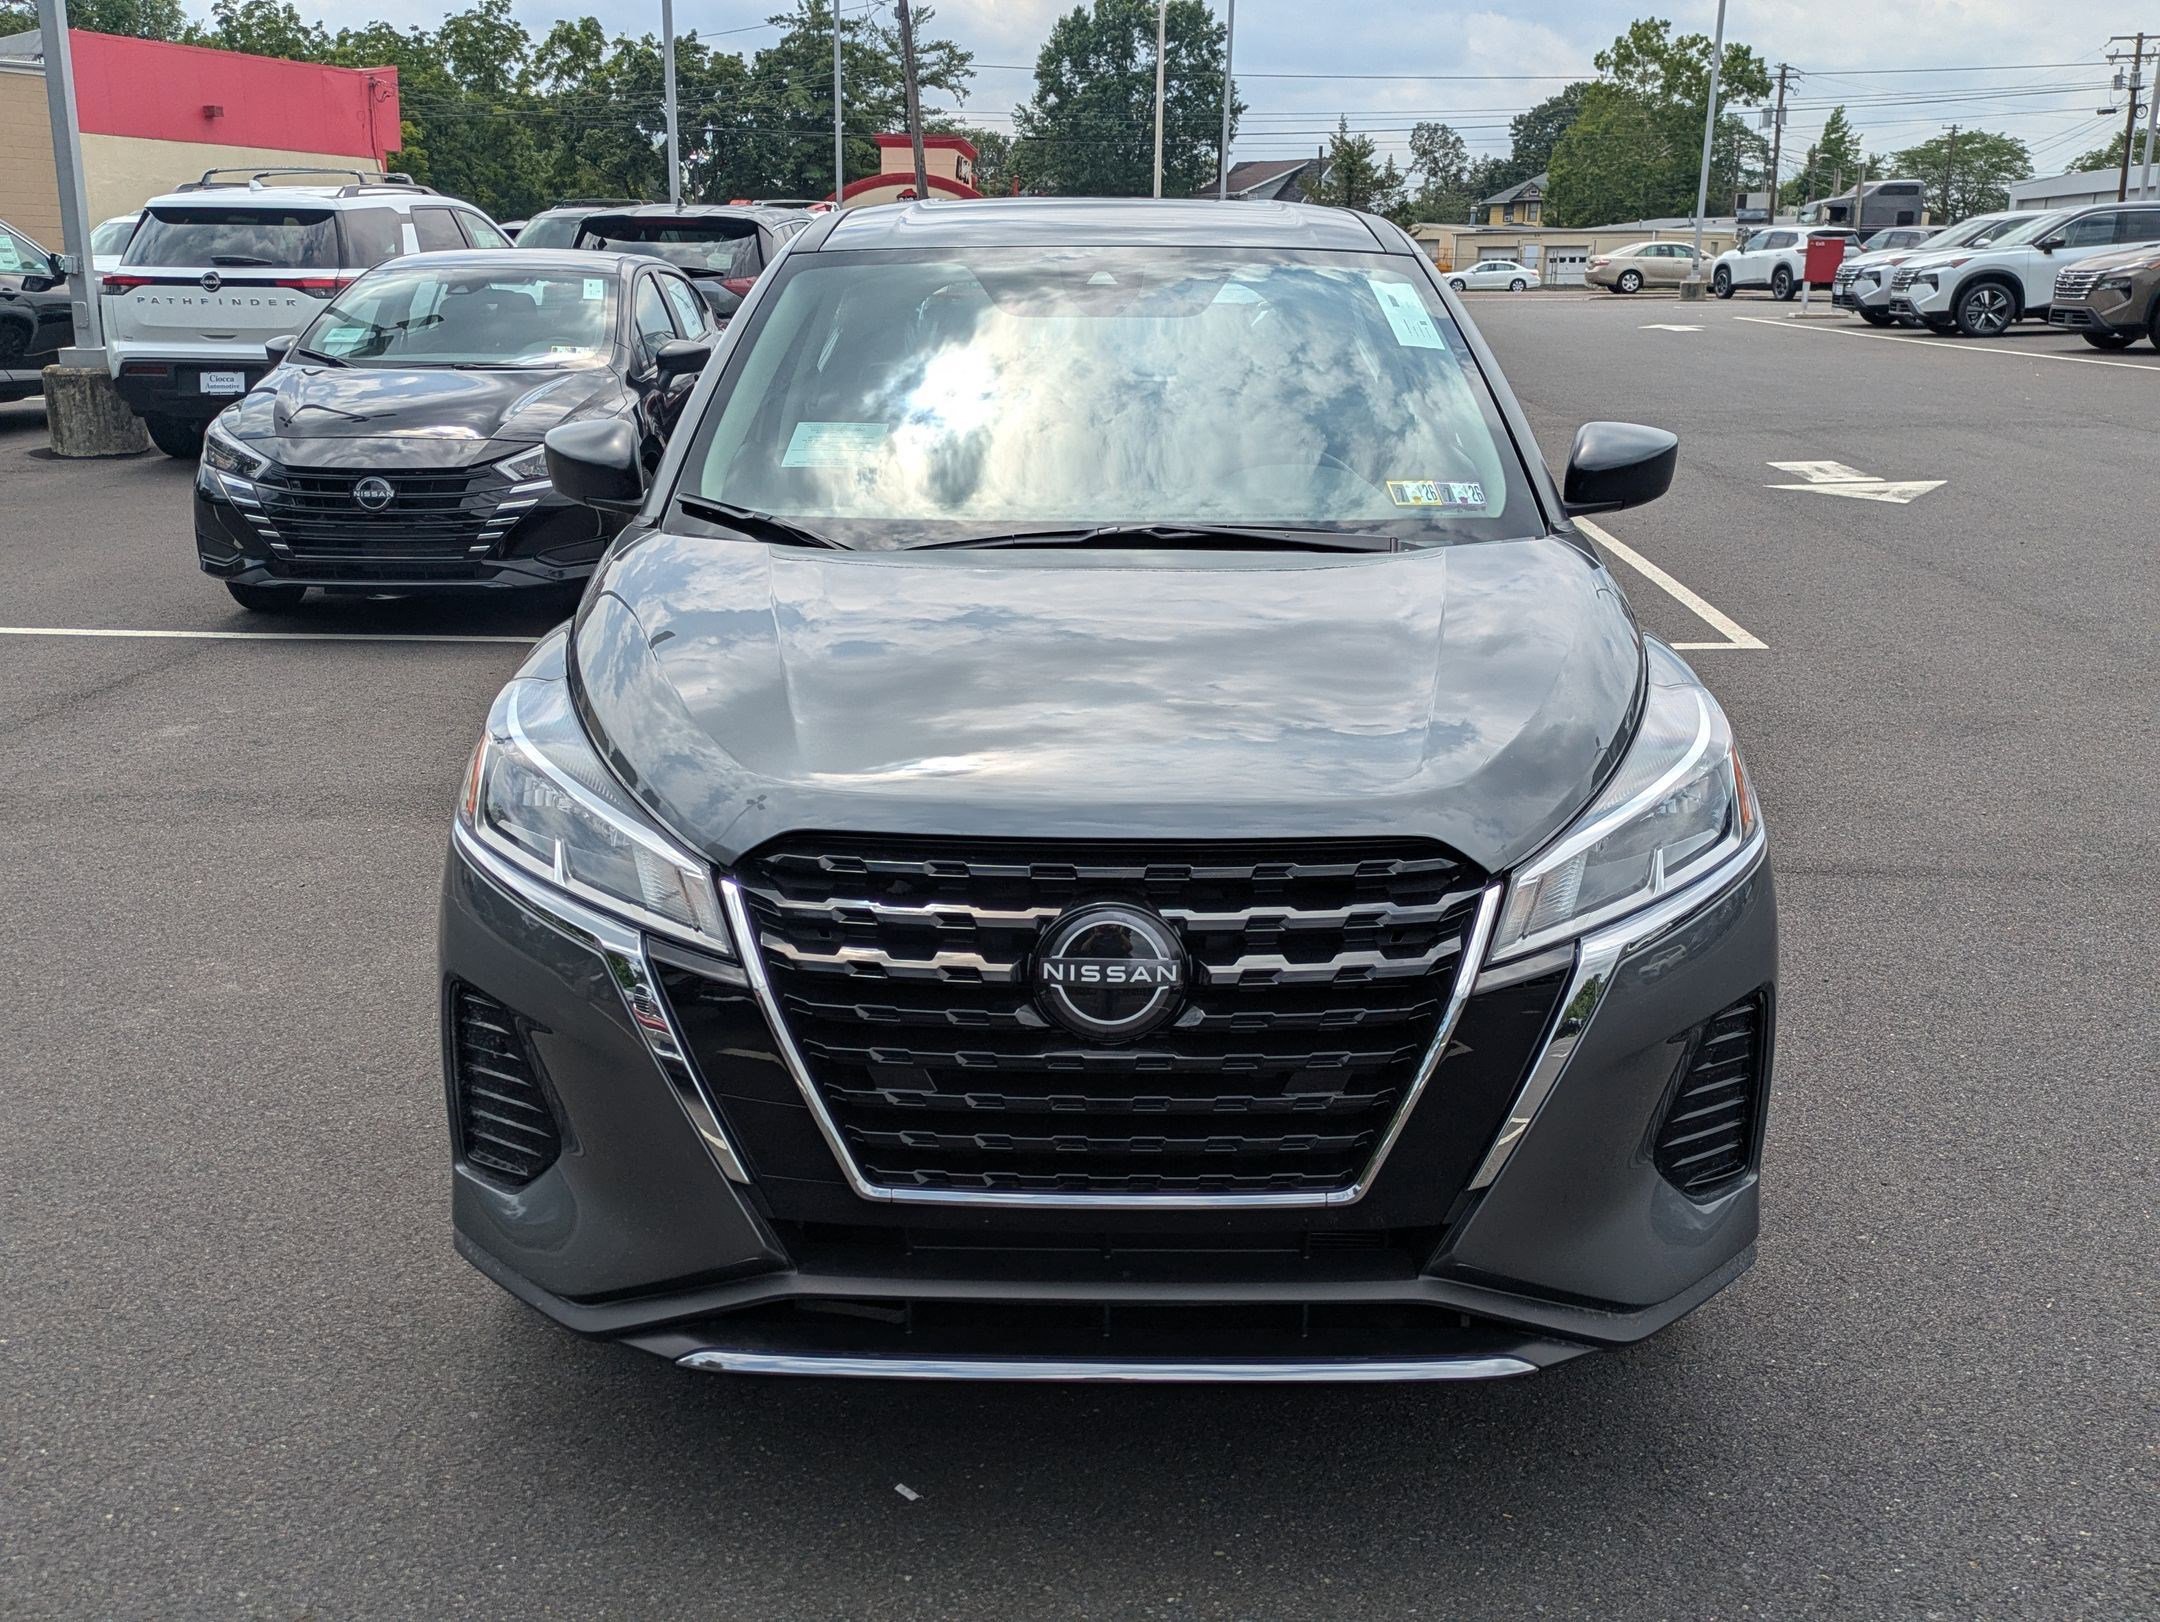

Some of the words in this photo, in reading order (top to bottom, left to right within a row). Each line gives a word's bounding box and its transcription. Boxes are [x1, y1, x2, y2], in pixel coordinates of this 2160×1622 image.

[137, 296, 297, 307] PATHFINDER
[209, 374, 235, 383] Ciocca
[353, 490, 395, 498] NISSAN
[1421, 484, 1438, 501] 26
[1468, 485, 1484, 502] 26
[1043, 962, 1177, 983] NISSAN
